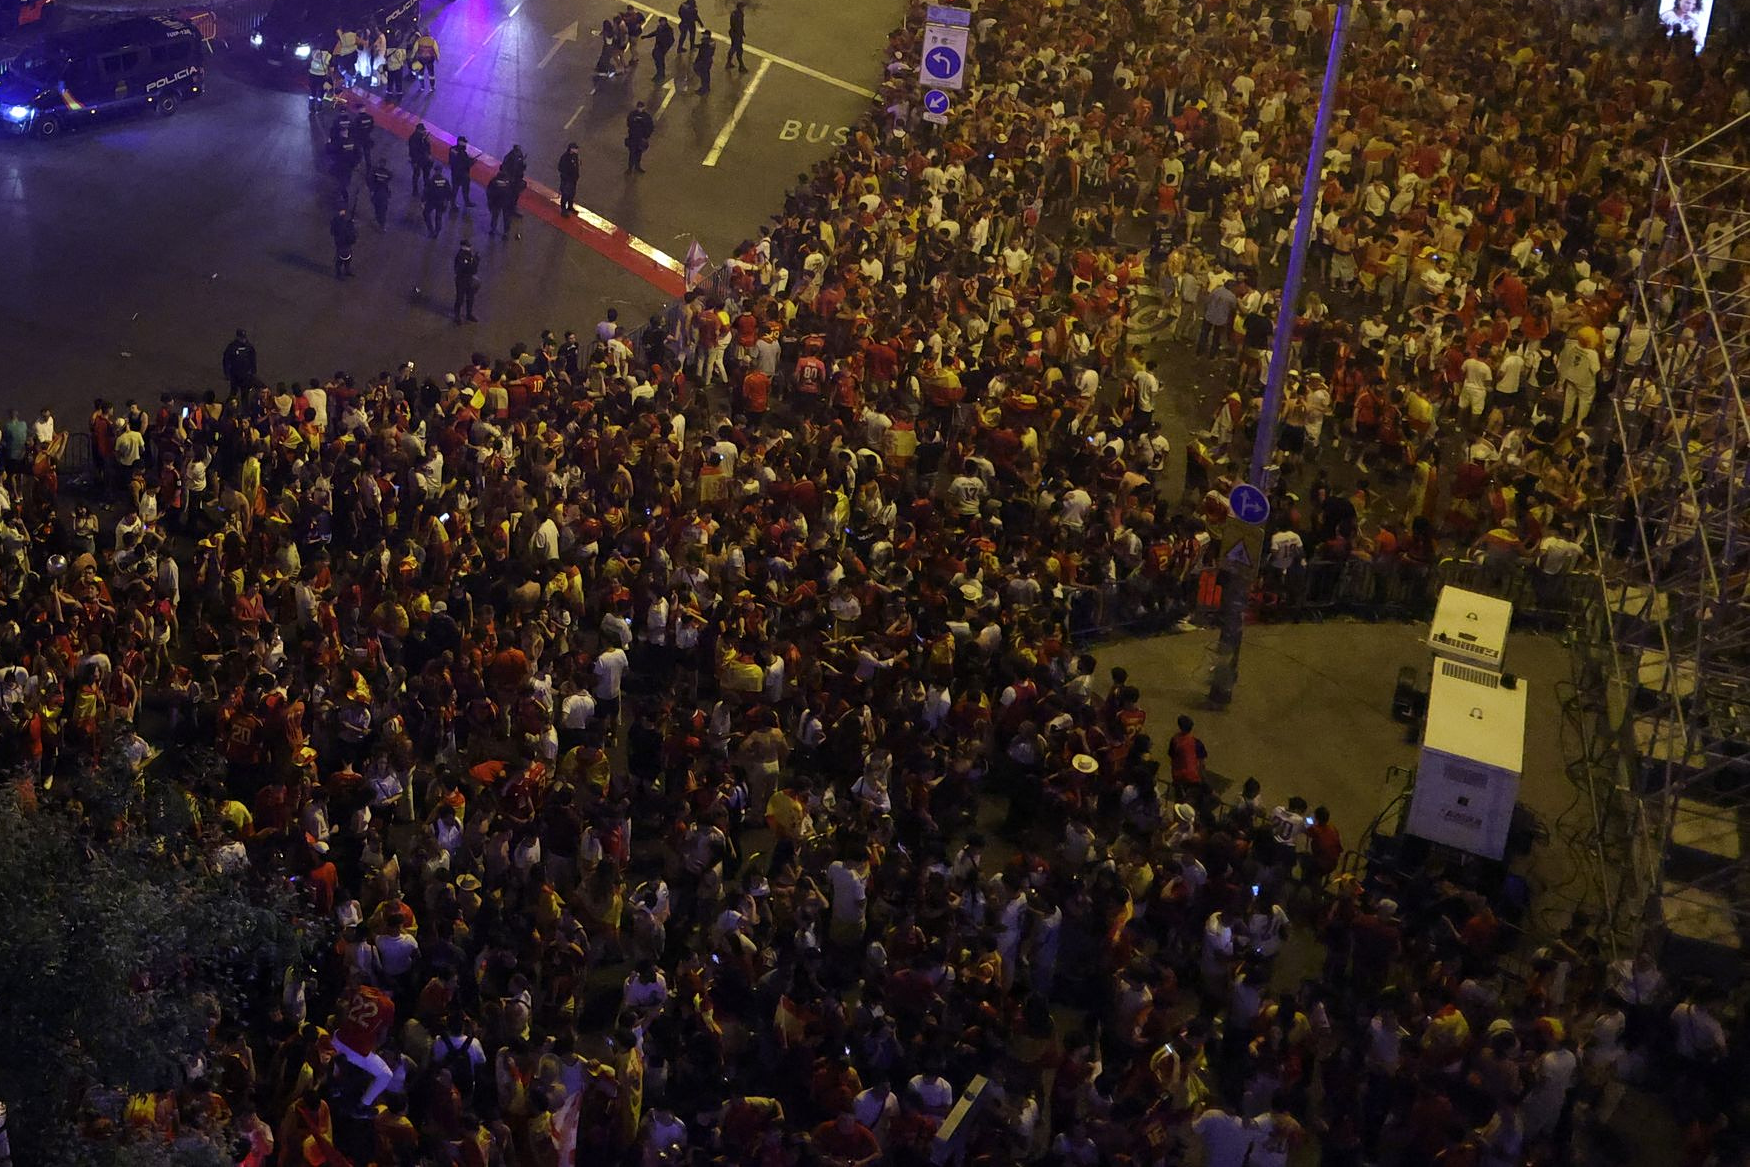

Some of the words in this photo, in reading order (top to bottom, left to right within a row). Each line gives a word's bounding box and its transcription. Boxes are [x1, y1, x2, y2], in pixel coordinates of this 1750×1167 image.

[778, 119, 850, 146] BUS
[533, 379, 544, 393] 10
[231, 723, 251, 745] 20
